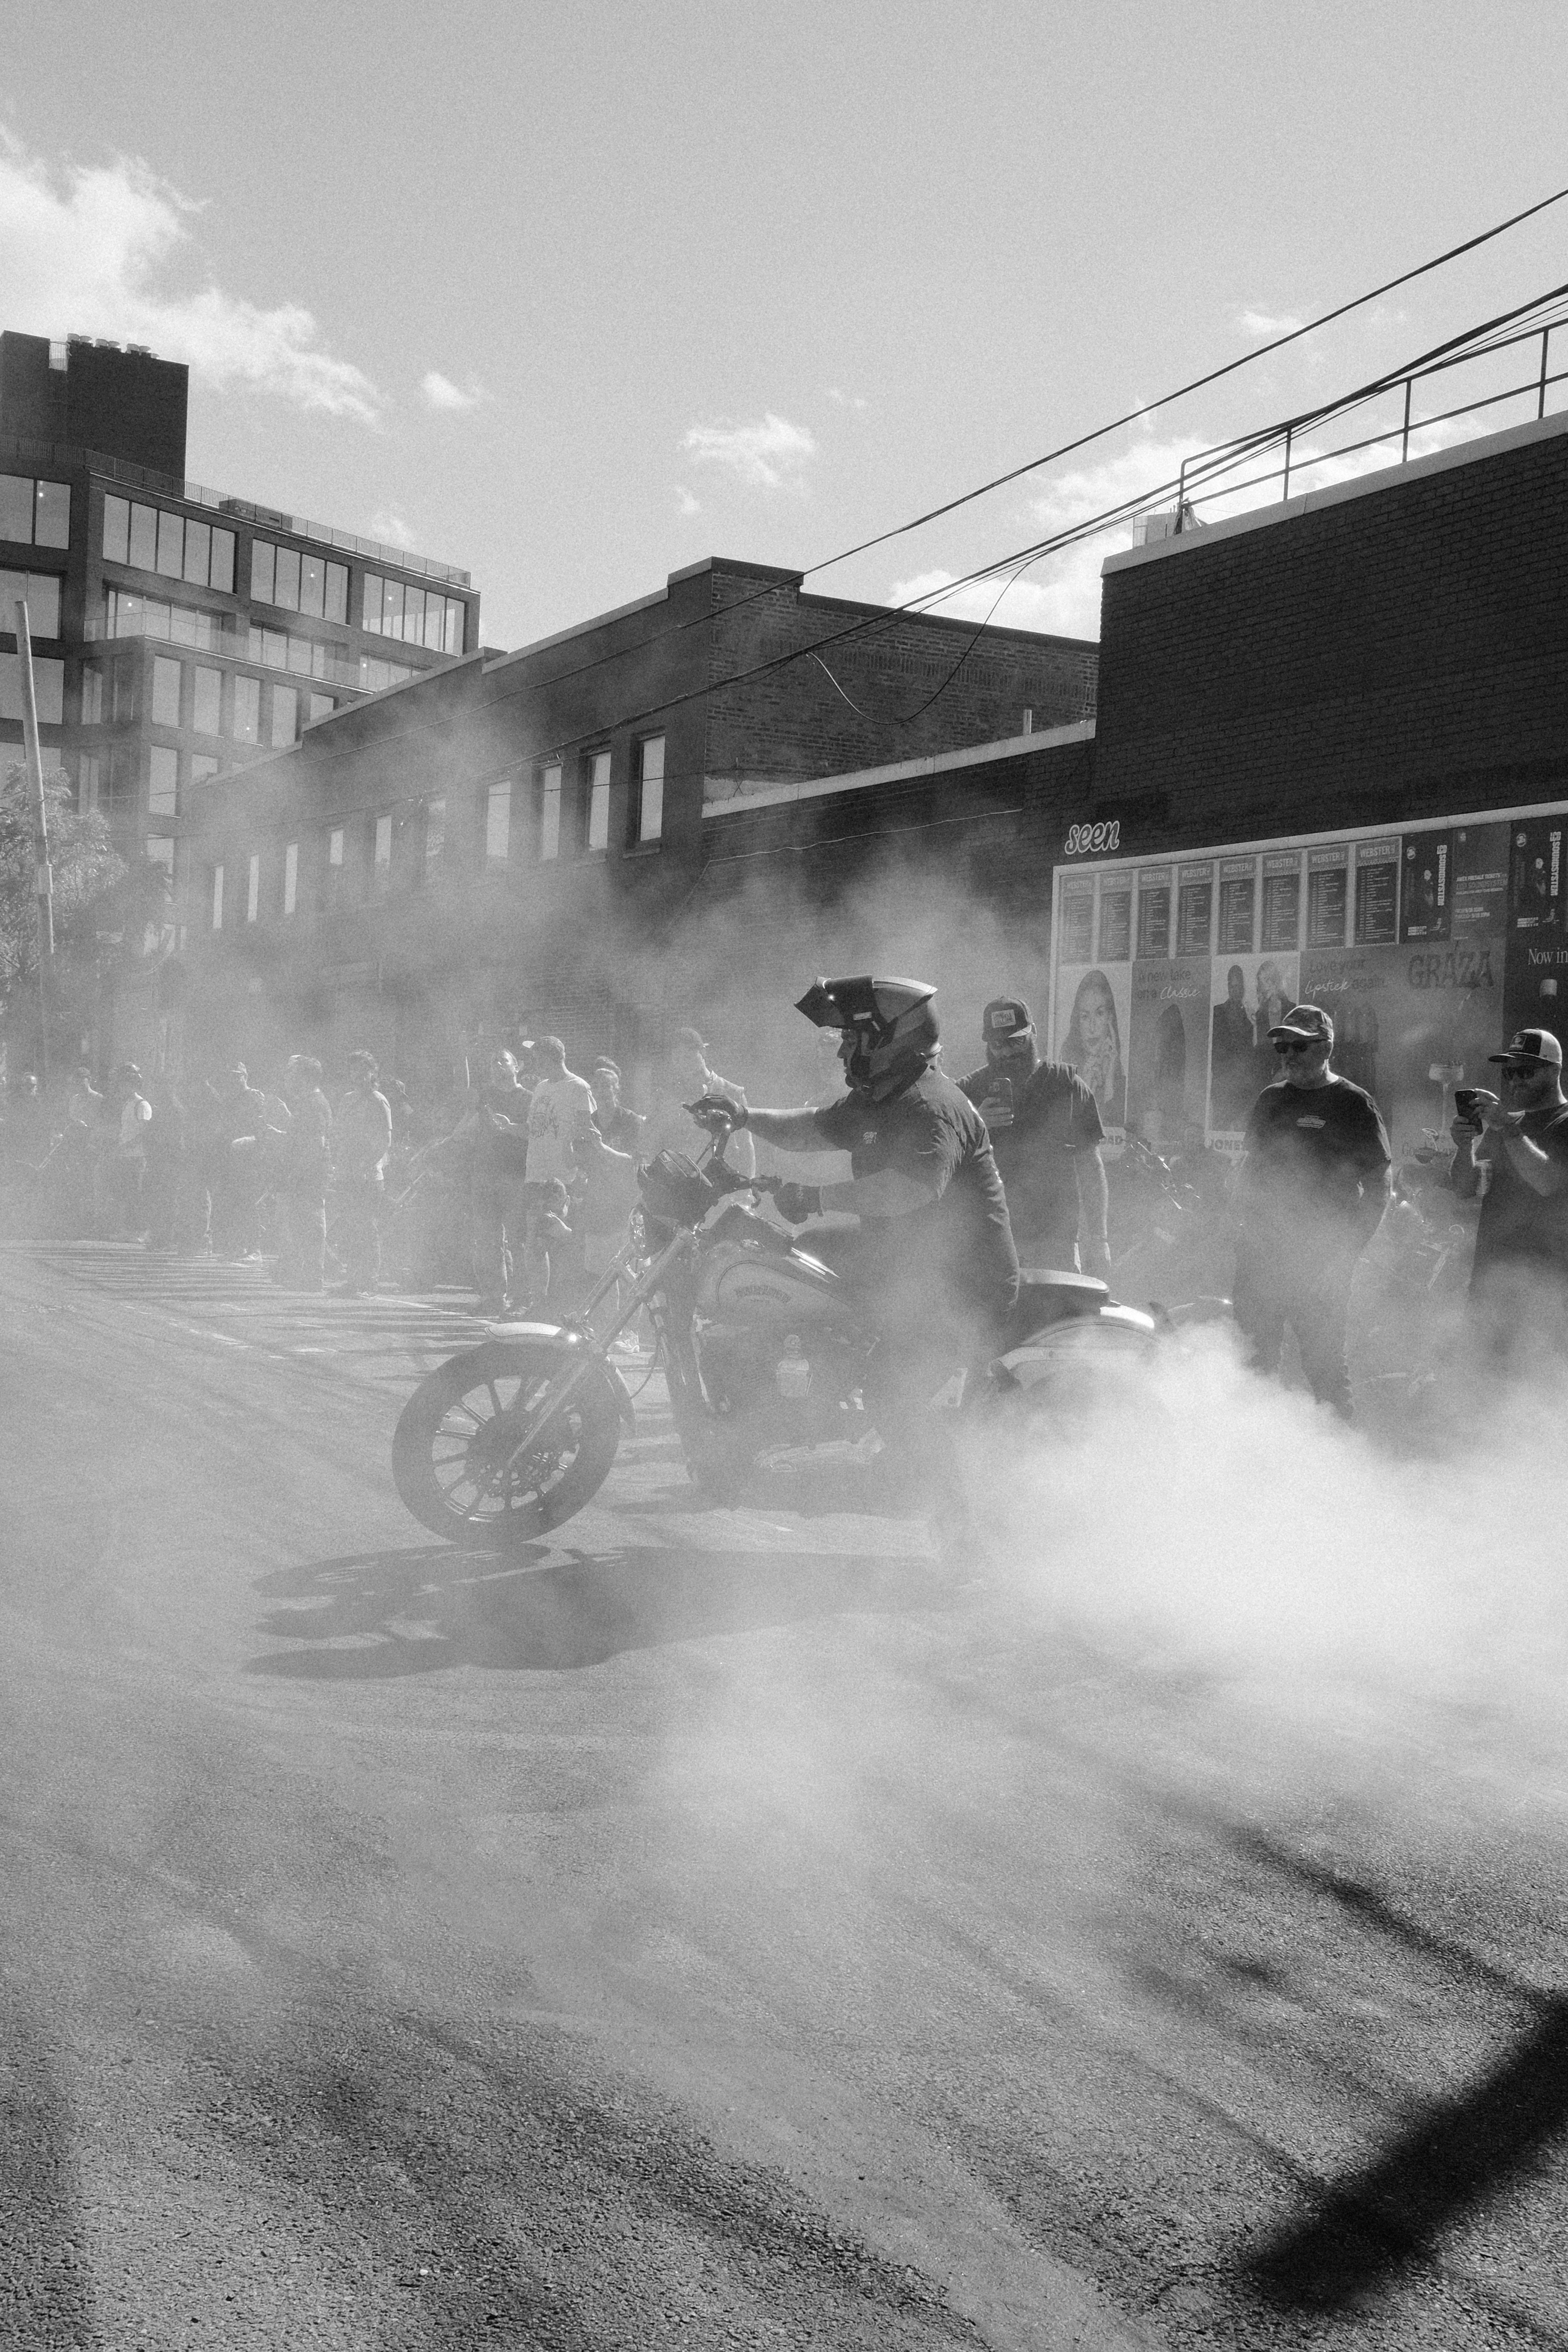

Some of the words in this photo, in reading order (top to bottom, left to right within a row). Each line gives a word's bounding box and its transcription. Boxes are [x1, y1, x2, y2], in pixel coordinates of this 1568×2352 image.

[1064, 820, 1120, 854] seen
[1312, 852, 1340, 863] WEBSTER
[1360, 845, 1390, 858] WEBSTER
[1223, 863, 1248, 873] WEBSTER
[1267, 858, 1293, 868] WEBSTER
[1550, 841, 1560, 896] SOUNDSYSTEM
[1141, 872, 1165, 882] WEBSTER
[1182, 868, 1207, 878] WEBSTER
[1437, 854, 1446, 906] SOUNDSYSTEM
[1528, 948, 1553, 965] Now
[1338, 959, 1366, 975] your
[1408, 951, 1494, 989] GRAZA
[1170, 968, 1191, 981] take
